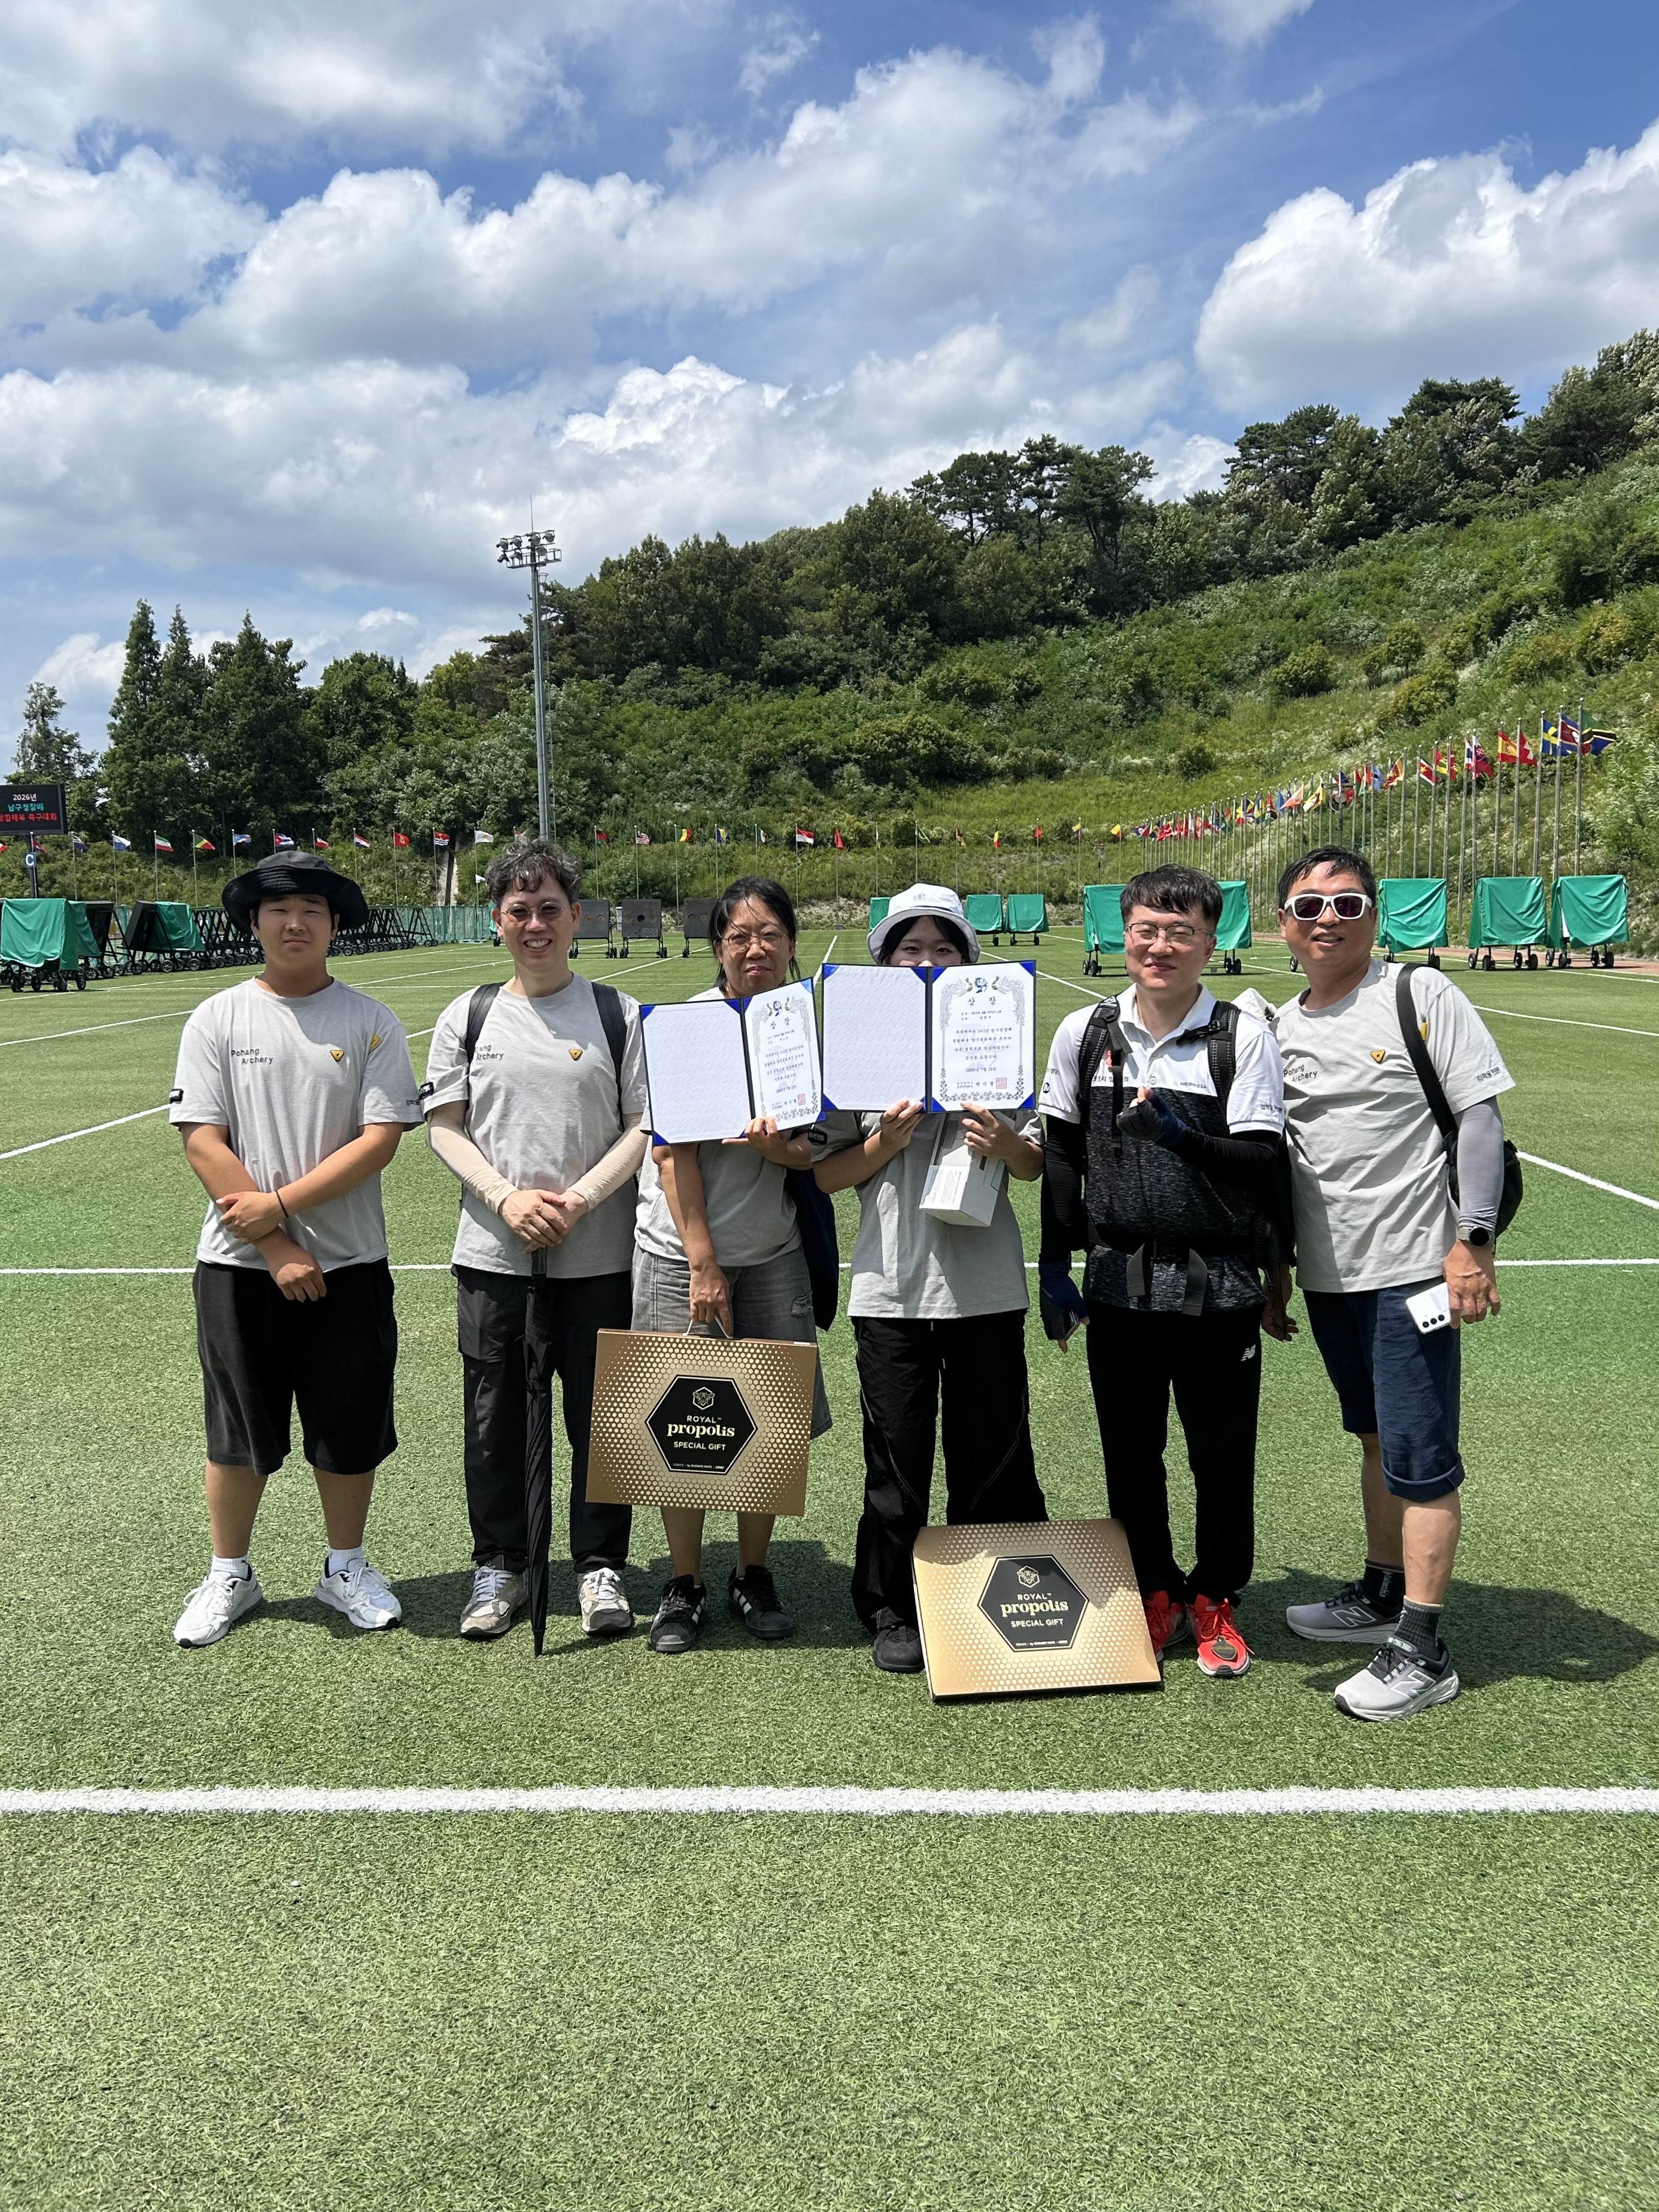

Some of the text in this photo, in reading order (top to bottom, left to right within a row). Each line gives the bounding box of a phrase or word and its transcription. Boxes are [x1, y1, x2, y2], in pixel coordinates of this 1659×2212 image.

[13, 793, 37, 801] 2026년
[26, 853, 35, 867] C
[231, 1048, 260, 1057] Pohang
[241, 1056, 274, 1065] Archery
[686, 1415, 716, 1423] ROYAL
[667, 1423, 735, 1438] propolis
[673, 1441, 706, 1450] SPECIAL
[1017, 1593, 1047, 1601] ROYAL
[1000, 1600, 1068, 1617] propolis
[1010, 1618, 1064, 1628] SPECIAL GIFT
